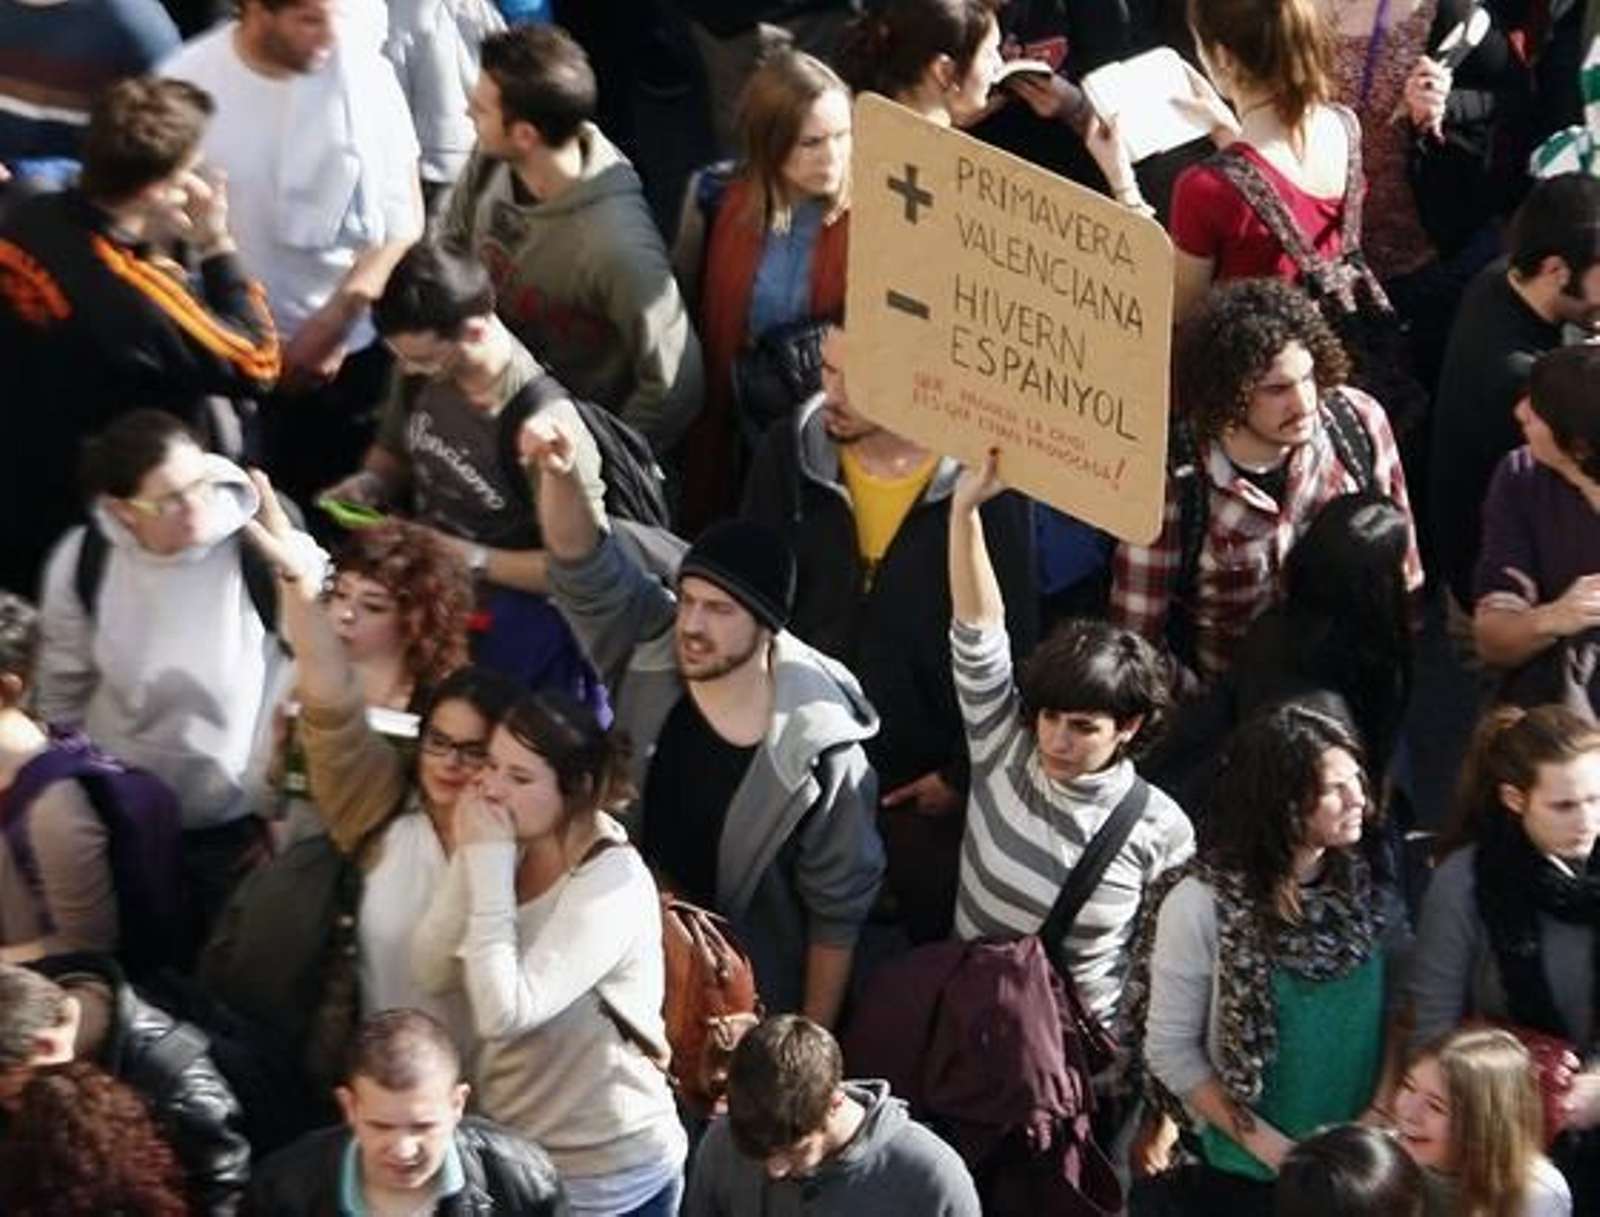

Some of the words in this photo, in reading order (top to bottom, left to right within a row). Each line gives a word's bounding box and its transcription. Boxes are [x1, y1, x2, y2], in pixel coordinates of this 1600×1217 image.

[957, 156, 1135, 269] PRIMAVERA
[954, 272, 1086, 371] HIVERN
[956, 212, 1143, 339] VALENCIANA
[952, 324, 1138, 440] ESPANYOL
